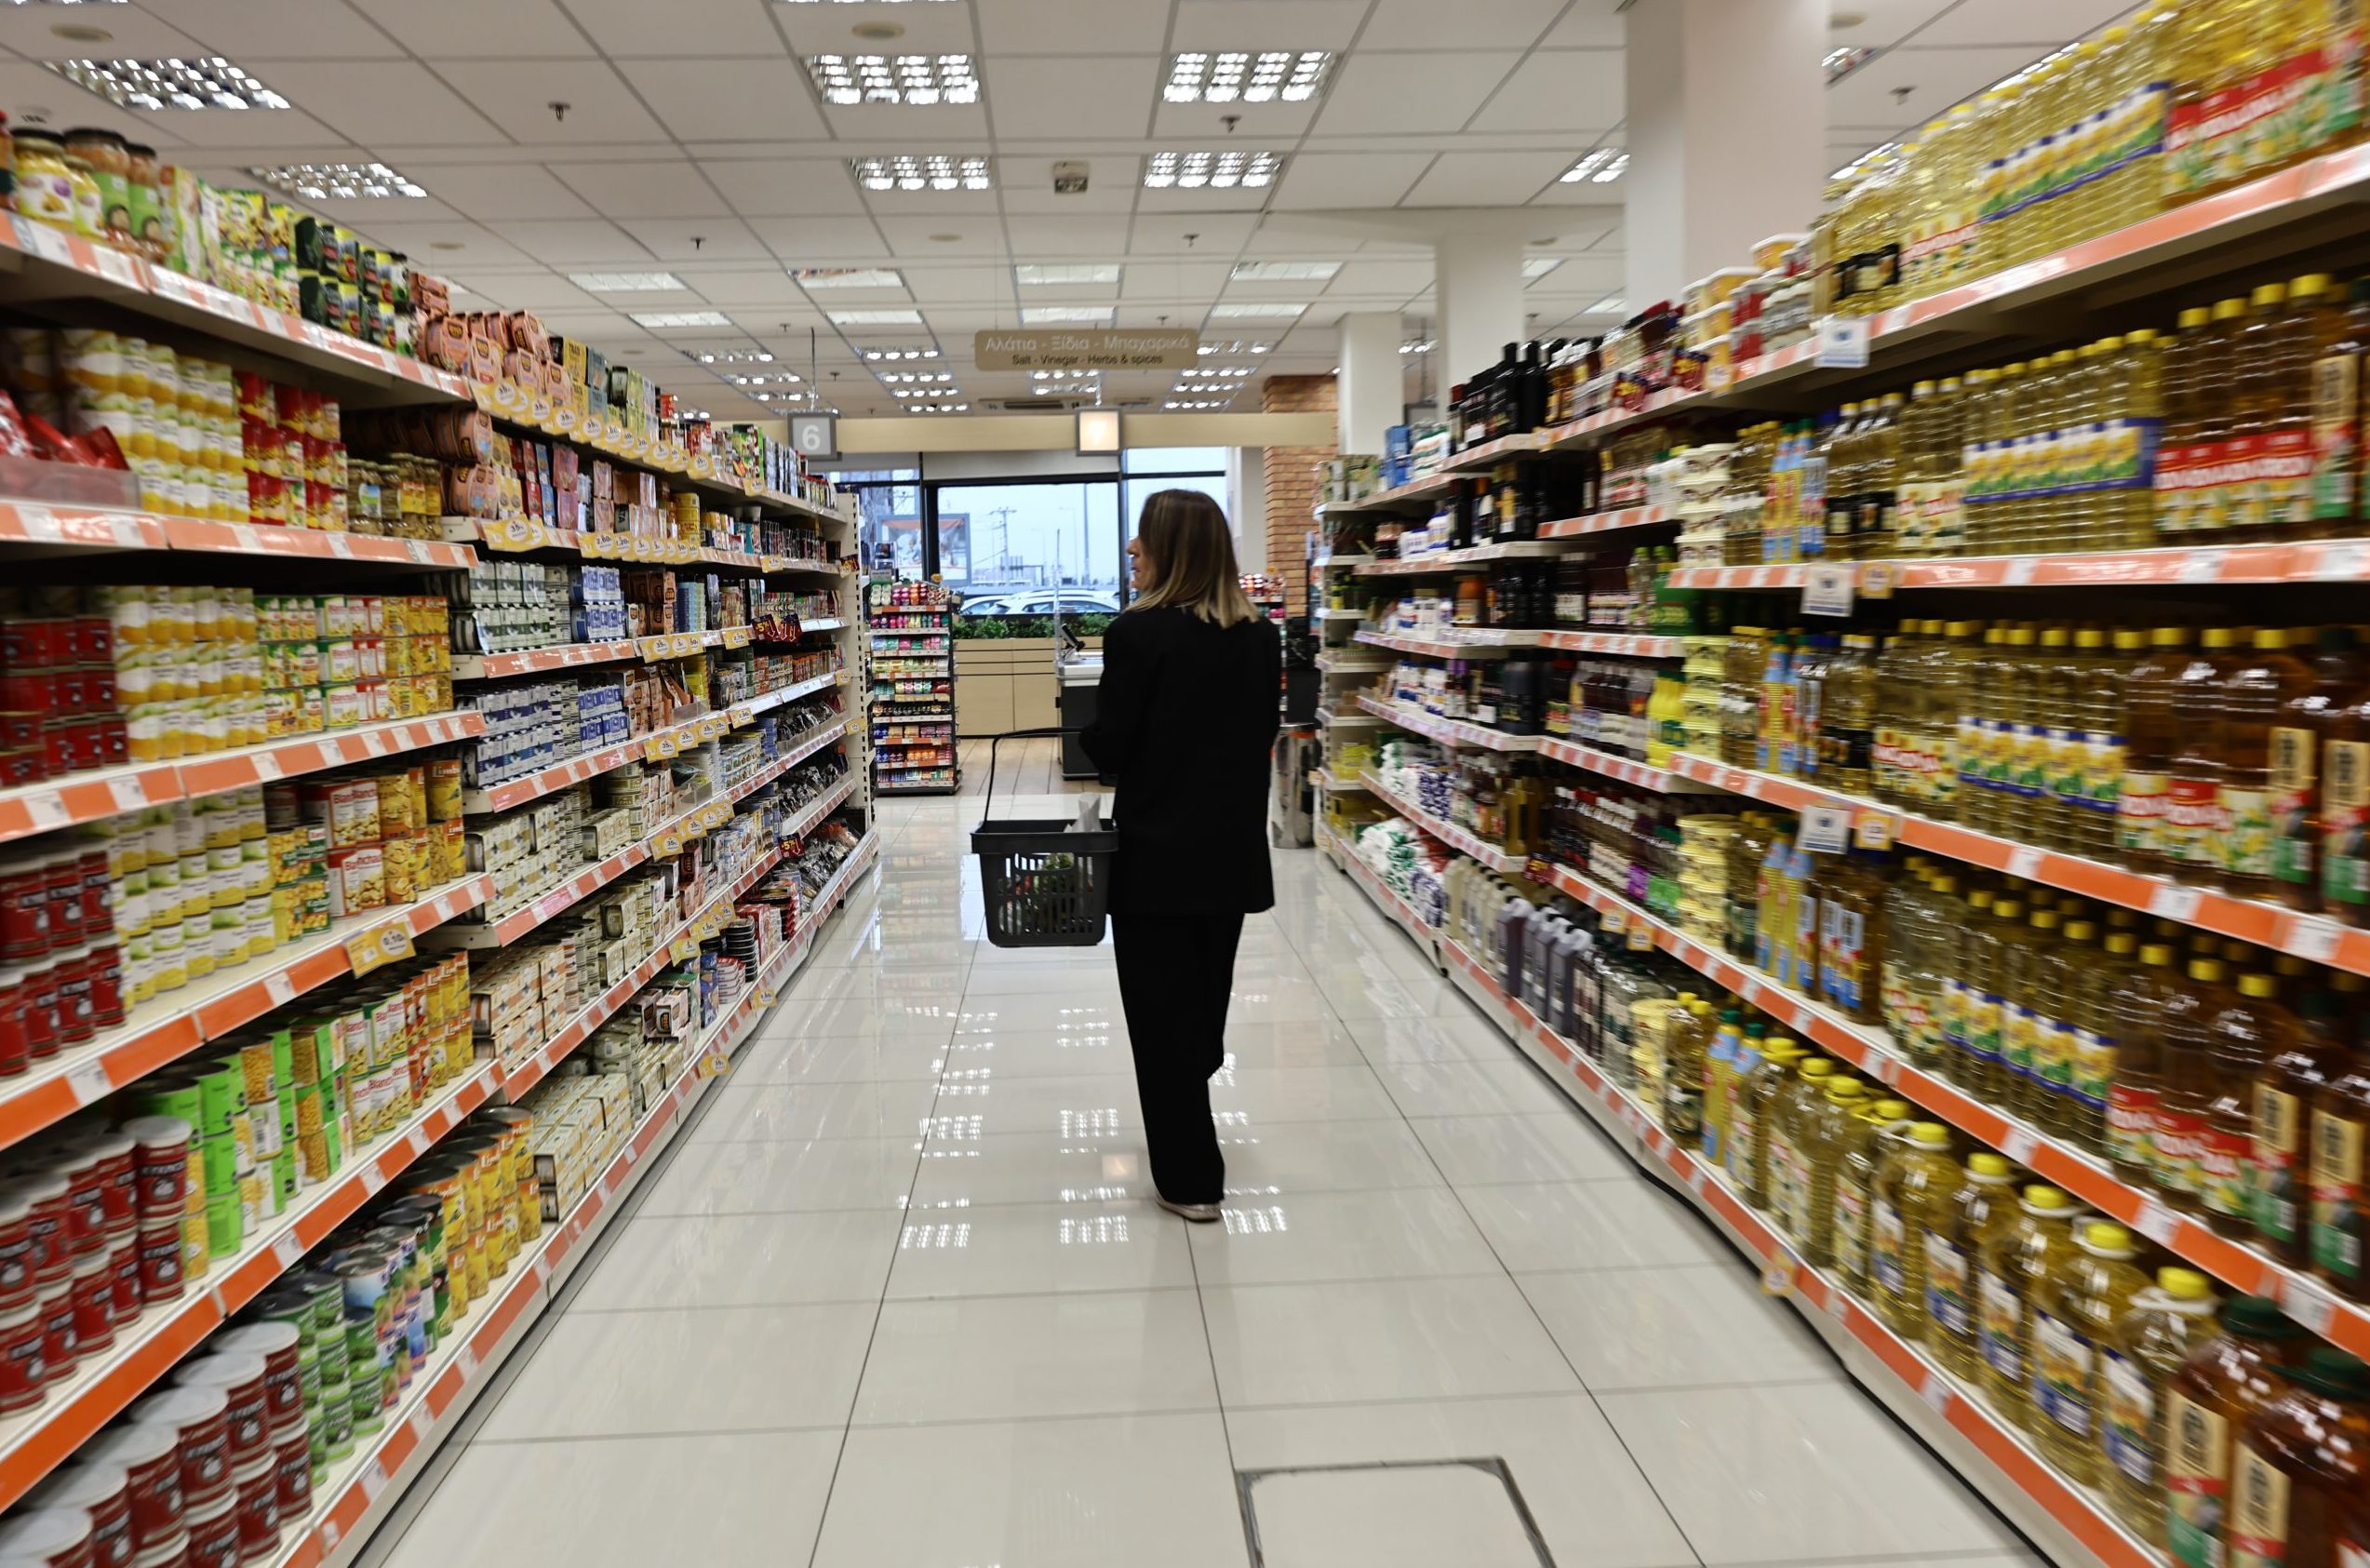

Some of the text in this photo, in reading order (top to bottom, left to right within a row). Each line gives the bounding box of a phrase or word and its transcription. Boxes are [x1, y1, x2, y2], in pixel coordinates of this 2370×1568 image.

[985, 336, 1037, 352] Αλάτια
[1051, 335, 1090, 351] Ξίδια
[1104, 334, 1189, 354] Μπαχαρικά
[1012, 355, 1031, 366] Salt
[1040, 355, 1078, 367] Vinegar
[1088, 354, 1118, 366] Herbs
[1121, 354, 1129, 365] &
[1131, 355, 1164, 367] spices
[802, 424, 821, 451] 6
